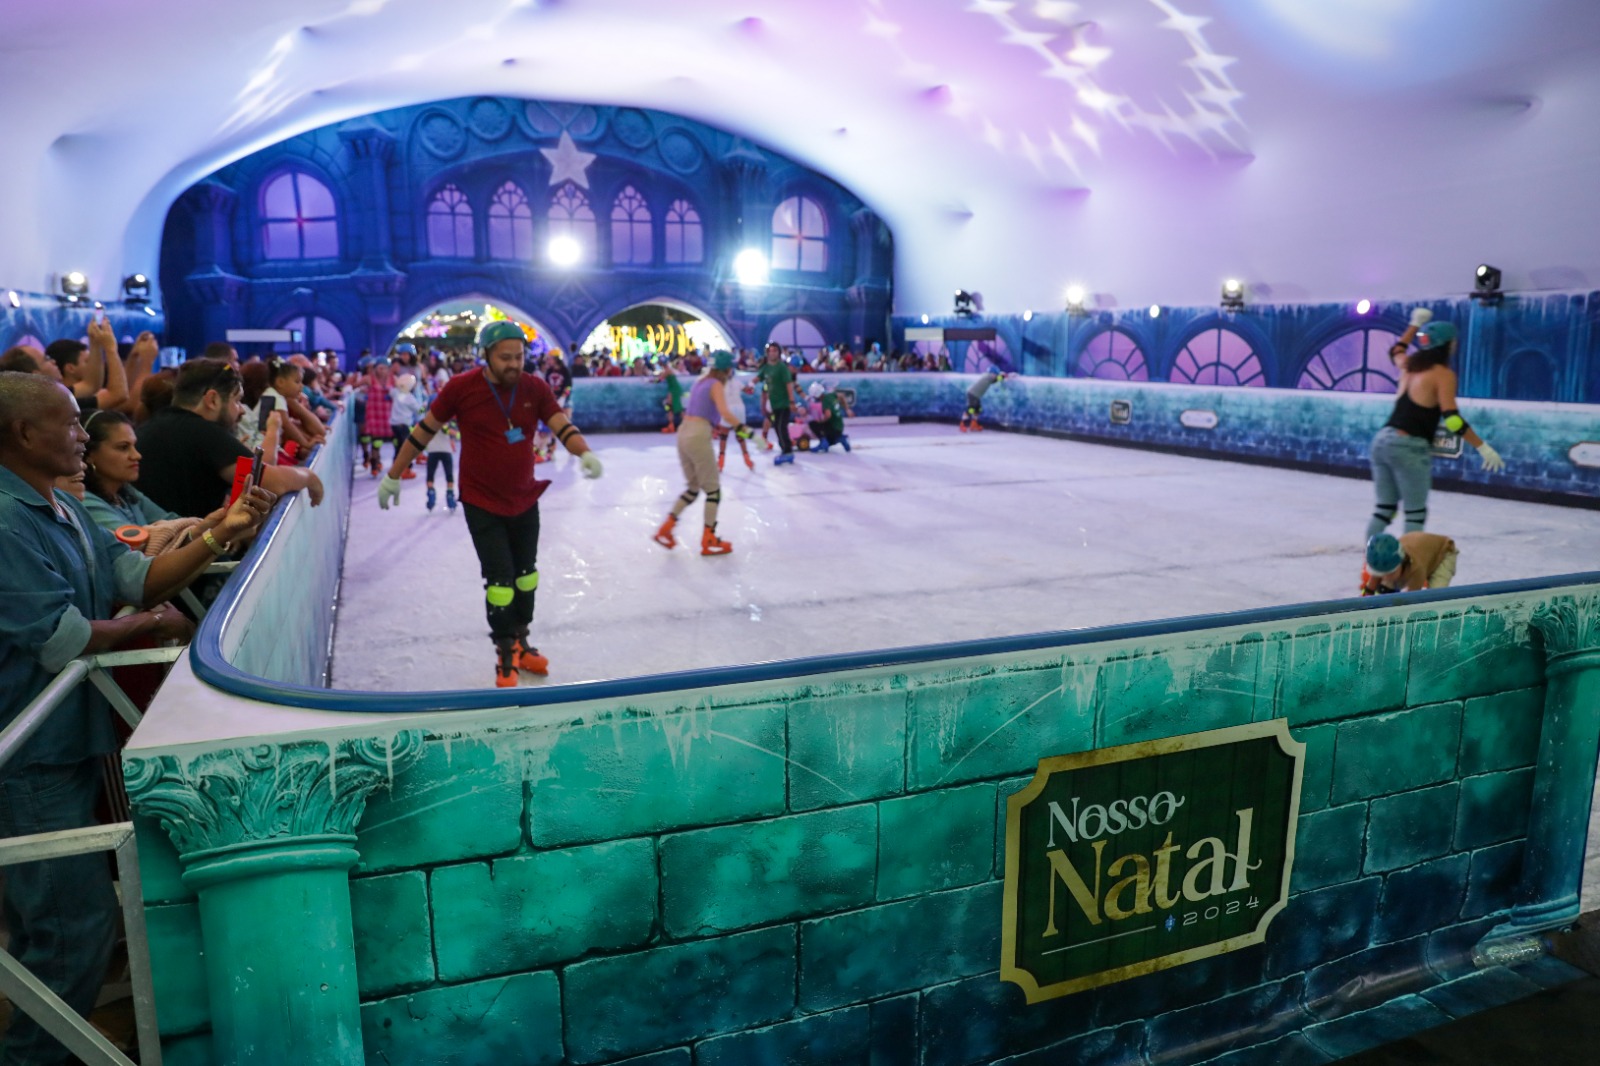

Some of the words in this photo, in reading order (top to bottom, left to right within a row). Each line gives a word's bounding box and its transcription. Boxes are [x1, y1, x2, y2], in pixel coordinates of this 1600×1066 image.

[1047, 791, 1185, 847] Nosso
[1042, 808, 1262, 937] Natal
[1183, 896, 1259, 926] 2024
